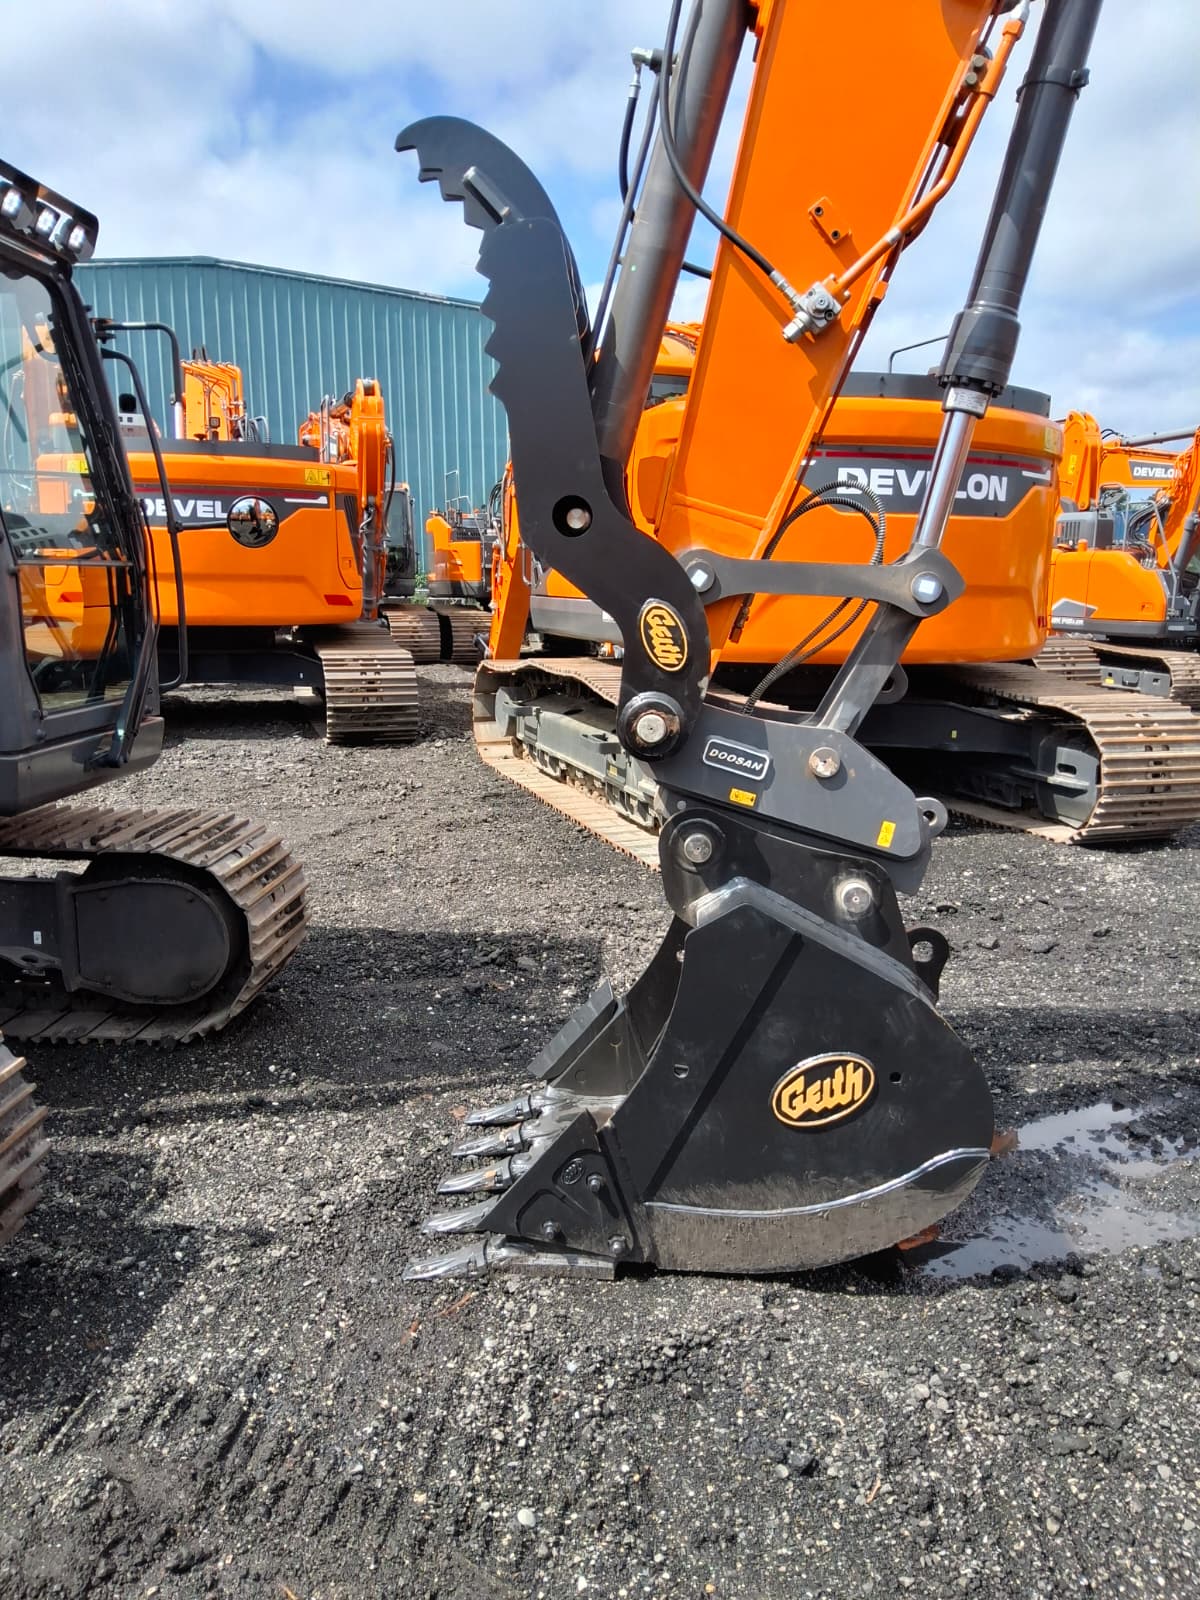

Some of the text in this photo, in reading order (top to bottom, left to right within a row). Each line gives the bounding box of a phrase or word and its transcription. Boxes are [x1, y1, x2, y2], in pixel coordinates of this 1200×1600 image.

[836, 467, 1008, 502] DEVON
[709, 748, 763, 771] DOOSAN
[781, 1062, 863, 1119] Geith
